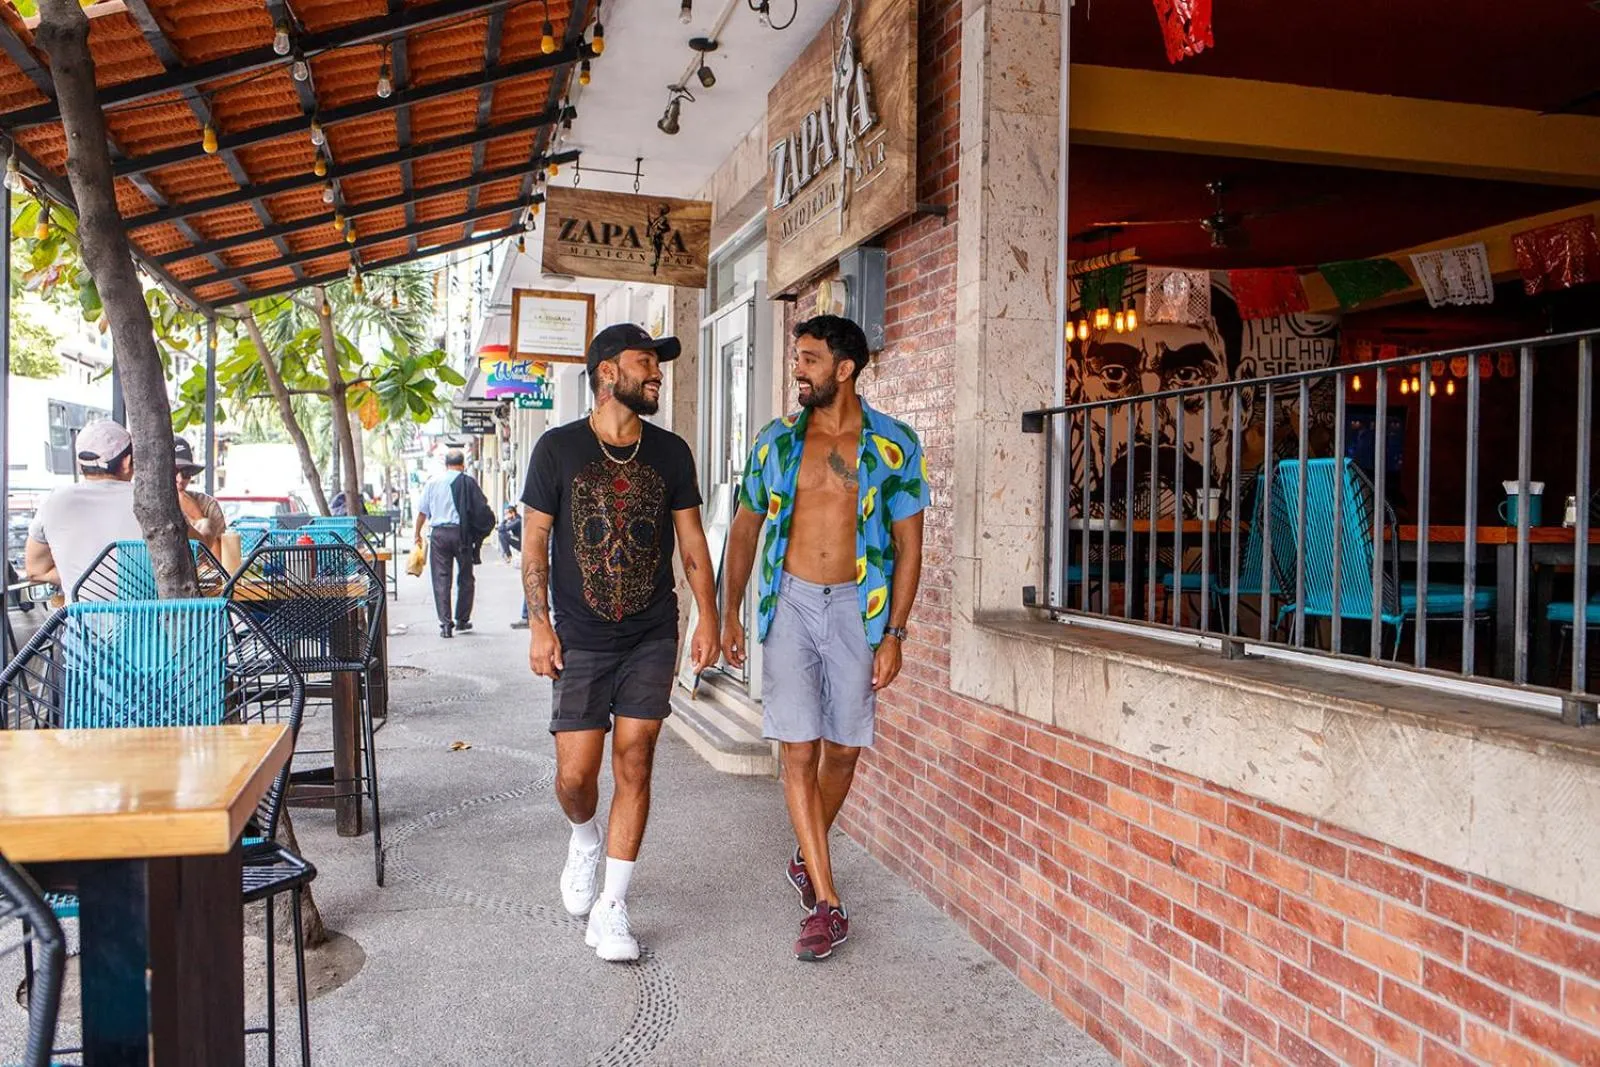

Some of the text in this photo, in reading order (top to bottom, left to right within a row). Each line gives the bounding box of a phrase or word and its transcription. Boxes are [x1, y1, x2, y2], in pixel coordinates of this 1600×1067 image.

[769, 62, 873, 210] ZAPAA
[854, 142, 886, 182] BAR
[557, 217, 689, 254] ZAPAA
[570, 247, 694, 266] MEXICAN BAR
[1261, 316, 1281, 335] LA
[1257, 337, 1325, 361] LUCHA
